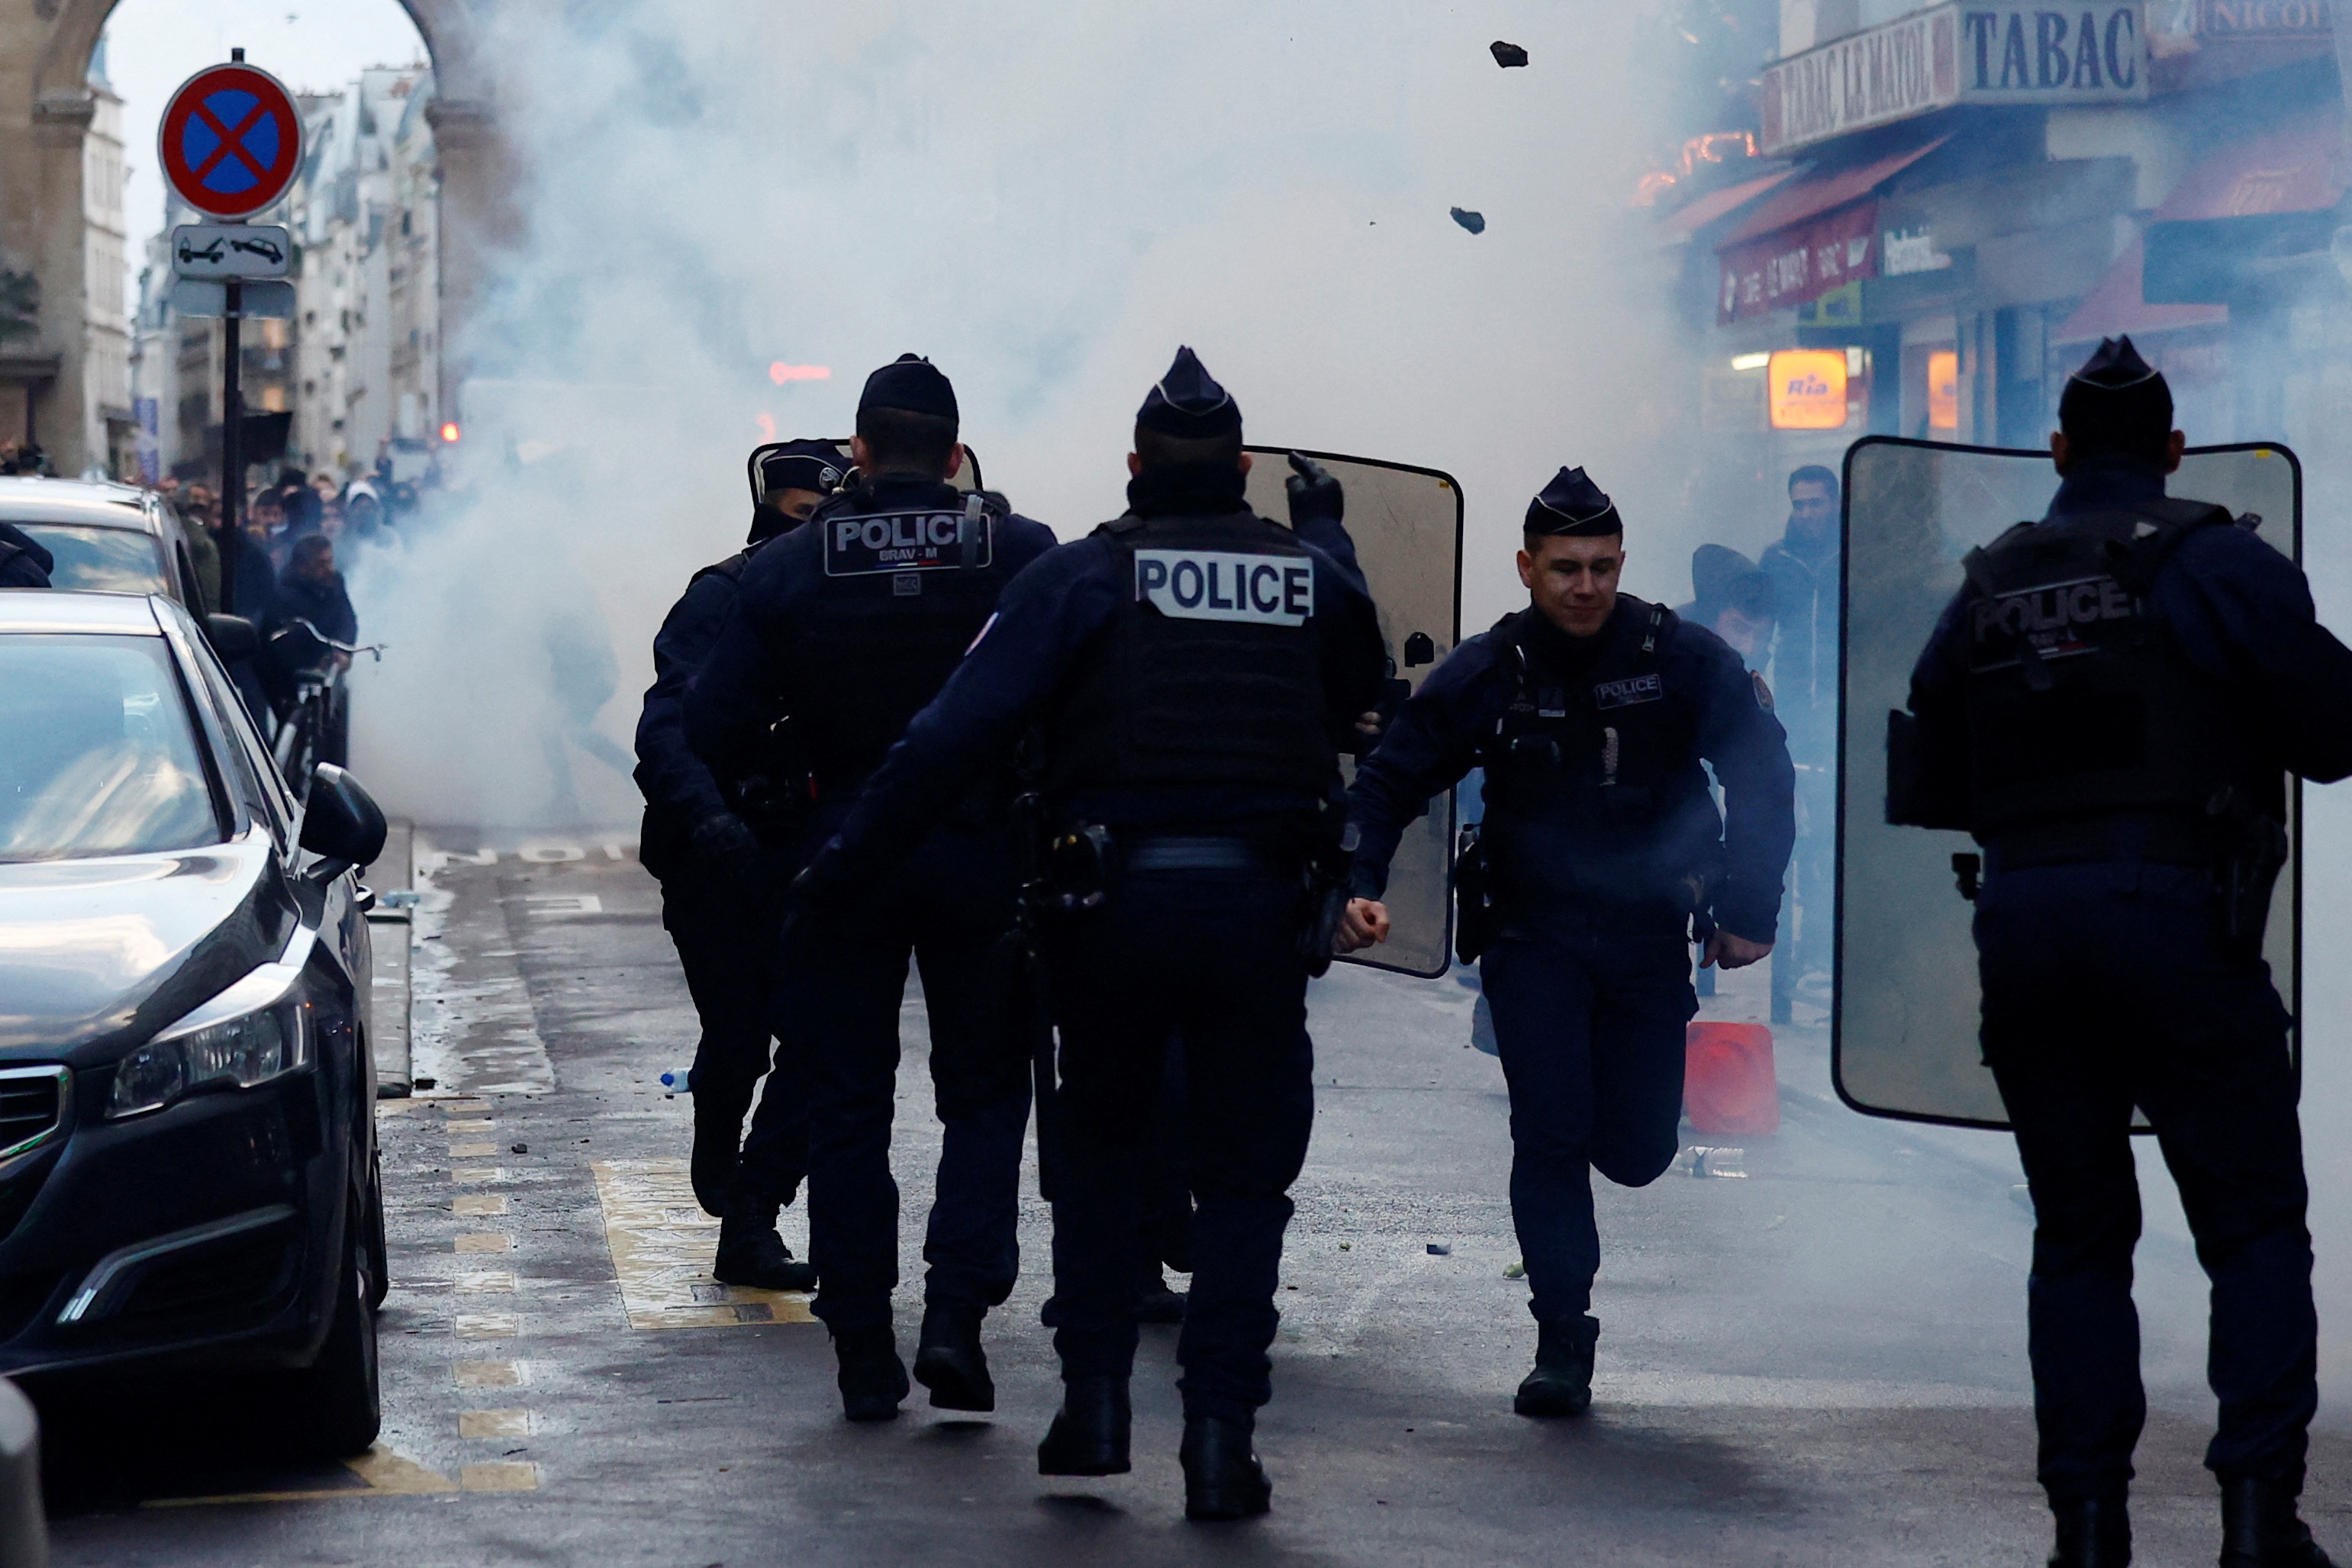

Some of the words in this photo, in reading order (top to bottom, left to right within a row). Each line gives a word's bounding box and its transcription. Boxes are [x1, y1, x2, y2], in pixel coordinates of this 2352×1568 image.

[1964, 8, 2137, 90] TABAC
[1788, 374, 1828, 395] Ria
[1138, 559, 1310, 616] POLICE
[1974, 581, 2131, 643] POLICE
[1600, 678, 1658, 700] POLICE
